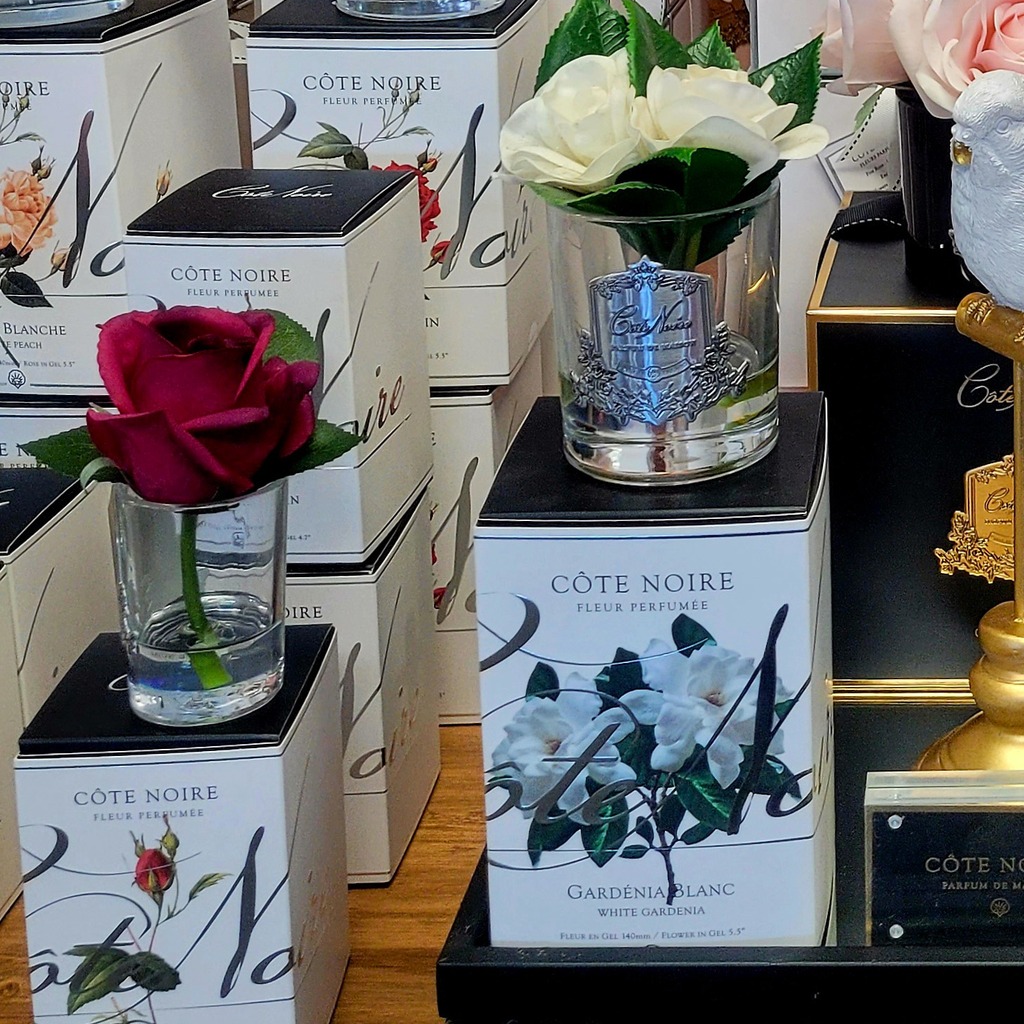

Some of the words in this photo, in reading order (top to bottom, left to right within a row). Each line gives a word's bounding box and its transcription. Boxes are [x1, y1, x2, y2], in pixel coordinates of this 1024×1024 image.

[303, 72, 362, 91] CÔTE
[371, 75, 442, 91] NOIRE
[0, 81, 50, 96] OIRE
[323, 97, 358, 105] FLEUR
[171, 265, 222, 282] CÔTE
[230, 269, 291, 282] NOIRE
[187, 288, 220, 296] FLEUR
[3, 322, 67, 335] BLANCHE
[14, 341, 42, 349] PEACH
[551, 571, 630, 594] CÔTE
[641, 572, 735, 593] NOIRE
[577, 602, 623, 612] FLEUR
[631, 599, 708, 612] PERFUMÉE
[286, 606, 323, 619] IRE
[73, 787, 136, 805] CÔTE
[145, 785, 219, 803] NOIRE
[93, 813, 133, 821] FLEUR
[925, 853, 991, 873] CÔTE
[567, 884, 666, 900] GARDÉNIA
[673, 883, 736, 898] BLANC
[942, 881, 988, 890] PARFUM
[993, 881, 1008, 890] DE
[597, 907, 638, 917] WHITE
[641, 906, 705, 916] GARDENIA
[560, 932, 585, 940] FLEUR
[601, 932, 618, 940] GEL
[622, 932, 651, 940] 140mm
[661, 931, 696, 939] FLOWER
[709, 929, 725, 937] GEL
[728, 927, 745, 936] 5.5"
